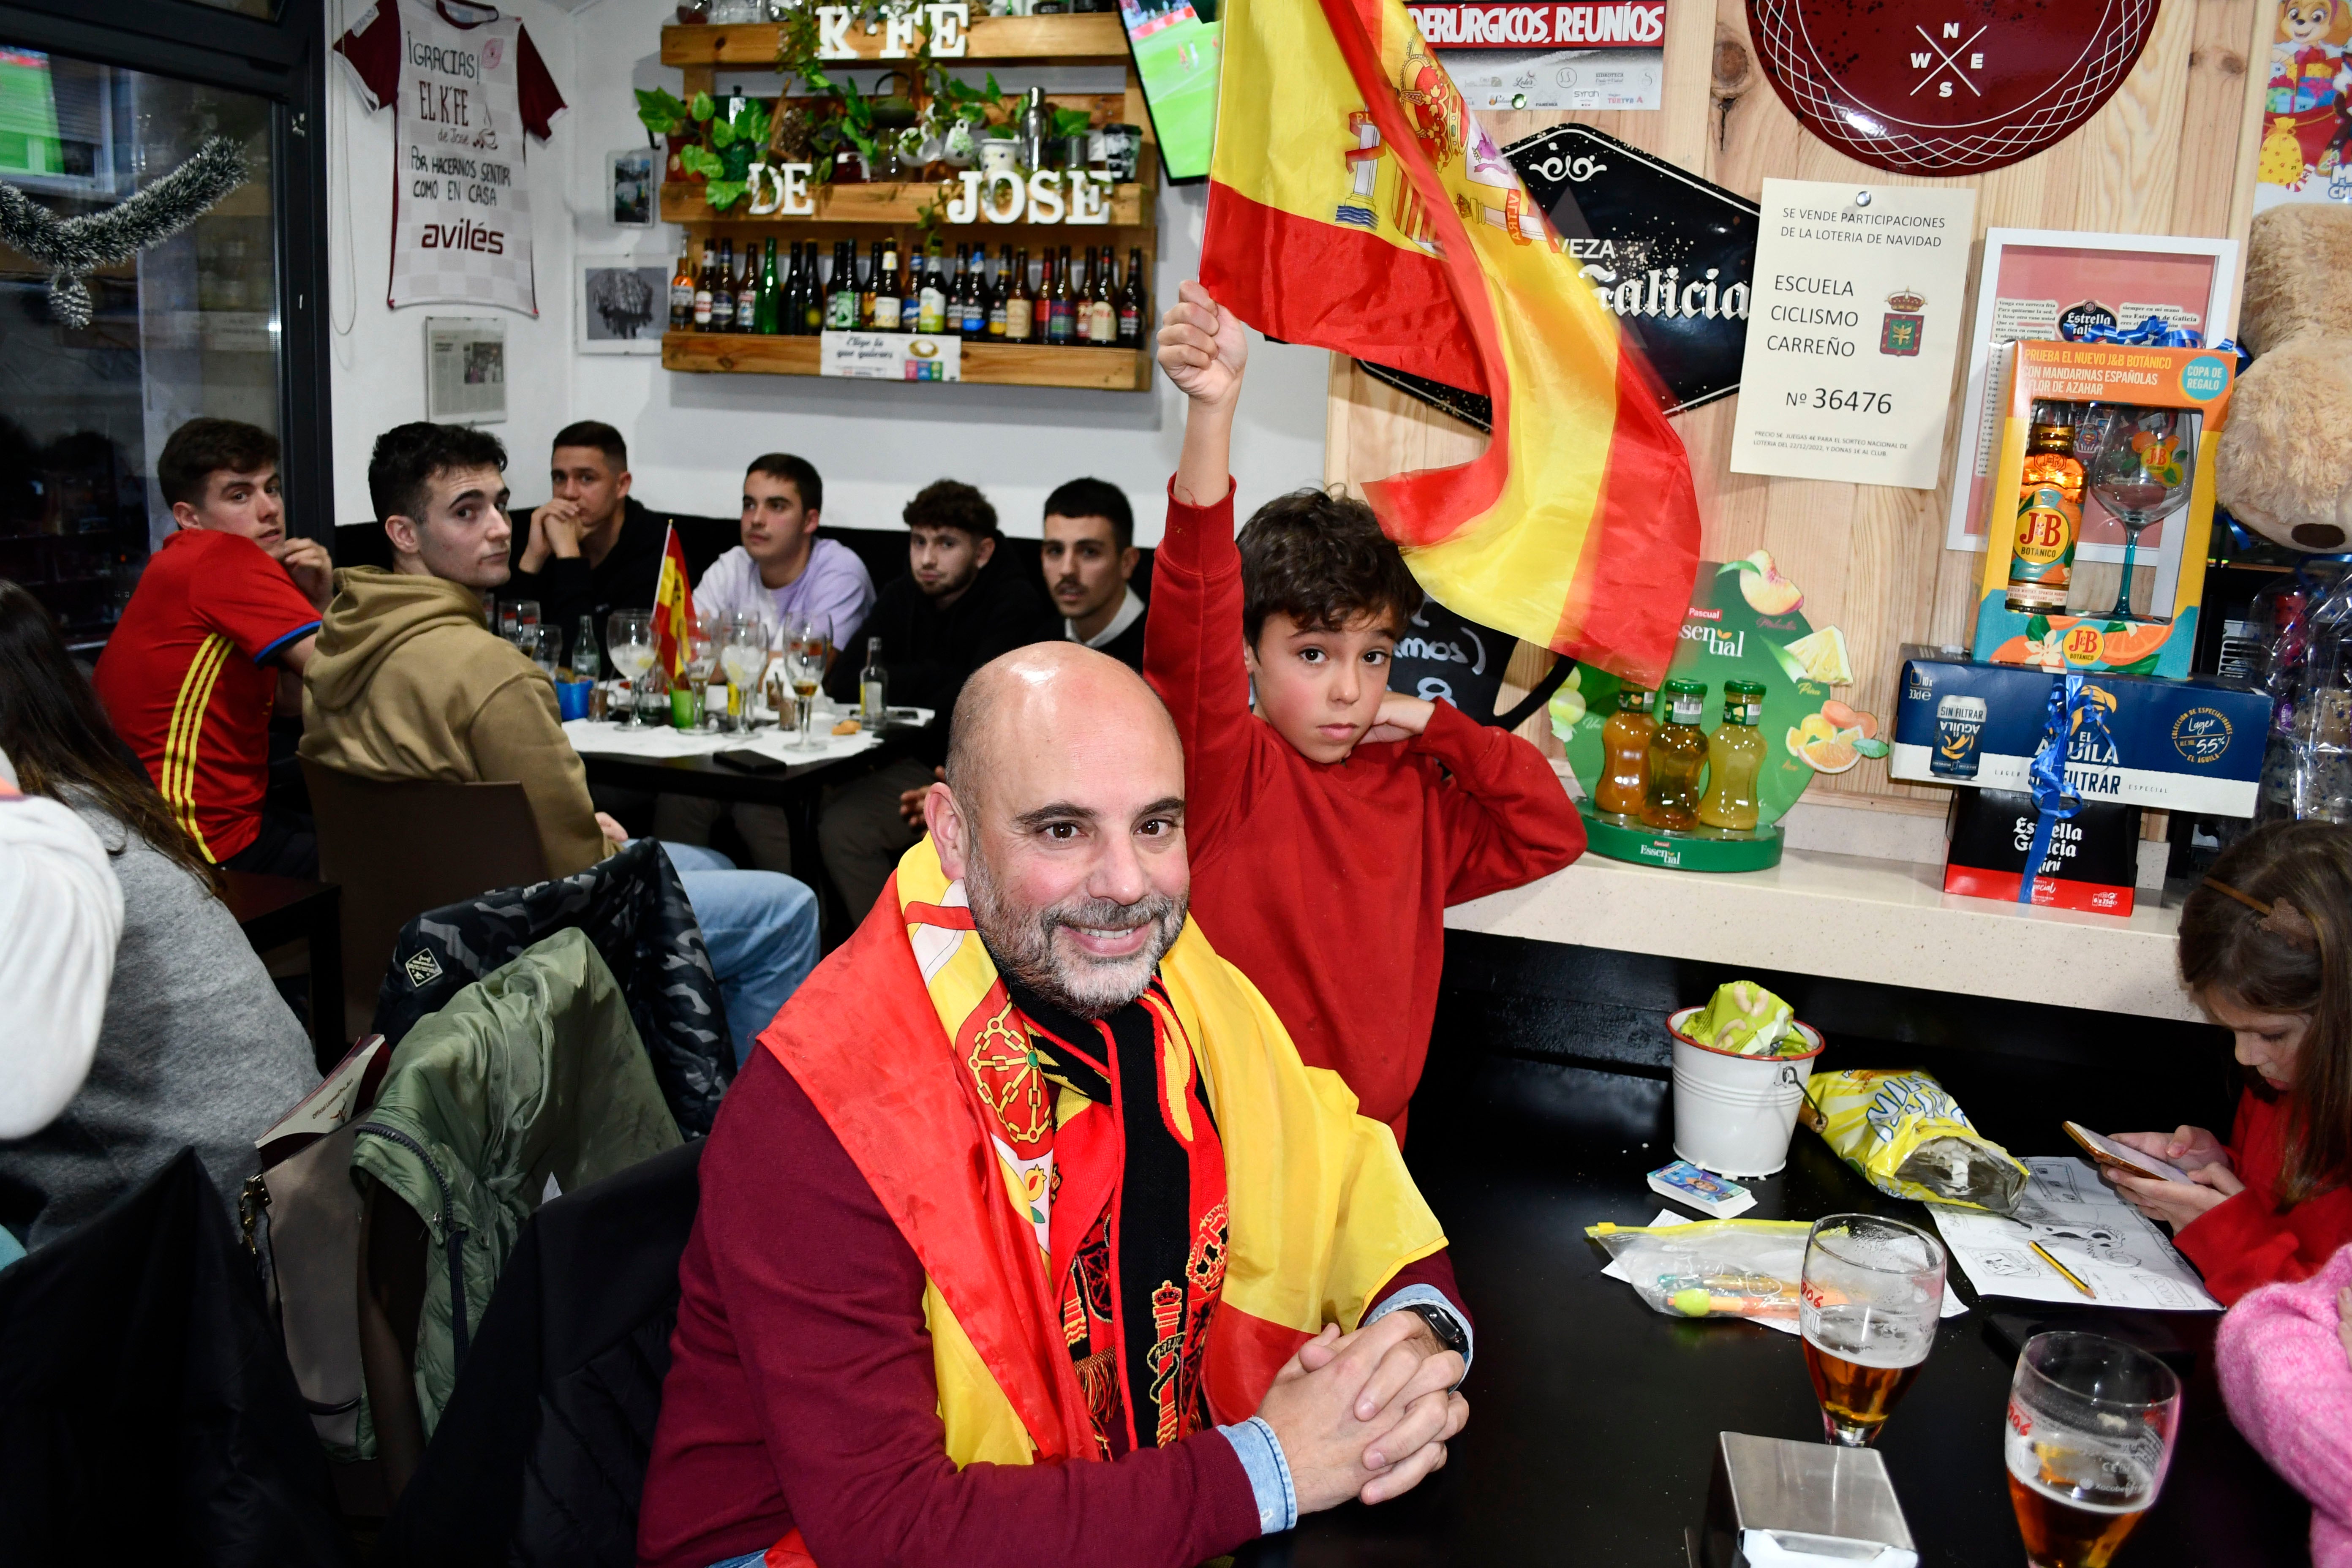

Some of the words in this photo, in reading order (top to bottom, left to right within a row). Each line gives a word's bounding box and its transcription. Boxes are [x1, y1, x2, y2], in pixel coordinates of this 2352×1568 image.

[1407, 4, 1552, 44] DERÚRGICOS,
[1555, 2, 1665, 42] REUNÍOS
[1943, 23, 1959, 38] N
[1910, 53, 1932, 68] W
[1971, 54, 1984, 68] E
[1938, 82, 1953, 98] S
[1356, 113, 1373, 124] PL
[432, 156, 476, 179] HACERNOS
[480, 164, 511, 187] SENTIR
[413, 180, 438, 199] COMO
[448, 182, 461, 201] EN
[468, 185, 497, 206] CASA
[748, 162, 813, 215] DE
[1782, 208, 1796, 218] SE
[1799, 209, 1838, 222] VENDE
[1841, 212, 1945, 229] PARTICIPACIONES
[421, 217, 504, 255] avilés
[1781, 226, 1795, 237] DE
[1799, 228, 1812, 239] LA
[1816, 229, 1863, 243] LOTERIA
[1867, 234, 1882, 244] DE
[1886, 234, 1941, 247] NAVIDAD
[1560, 239, 1616, 259] VEZA
[1775, 275, 1854, 297] ESCUELA
[1771, 305, 1859, 327] CICLISMO
[1767, 335, 1855, 357] CARREÑO
[2024, 349, 2060, 362] PRUEBA
[2062, 351, 2072, 364] EL
[2074, 352, 2105, 365] NUEVO
[2107, 354, 2124, 367] J&B
[2126, 354, 2172, 369] BOTÁNICO
[2043, 367, 2103, 381] MANDARINAS
[2104, 369, 2158, 385] ESPAÑOLAS
[2187, 366, 2209, 377] COPA
[2211, 368, 2223, 378] DE
[2030, 381, 2051, 392] FLOR
[2052, 382, 2064, 393] DE
[2066, 383, 2103, 395] AZAHAR
[2187, 378, 2219, 391] REGALO
[1813, 388, 1892, 414] 36476
[1867, 441, 1897, 449] NACIONAL
[2019, 512, 2062, 547] J&B
[1688, 607, 1720, 619] Pascual
[2069, 629, 2098, 653] J&B
[1941, 706, 1953, 716] SIN
[1955, 708, 1984, 720] FILTRAR
[2198, 707, 2232, 735] ESPECIALIDADES
[2188, 718, 2216, 735] Lager
[2080, 731, 2091, 743] EL
[2197, 736, 2225, 754] 5,5%
[1995, 769, 2020, 777] LAGER
[2129, 784, 2168, 794] ESPECIAL
[2013, 817, 2082, 841] Esella
